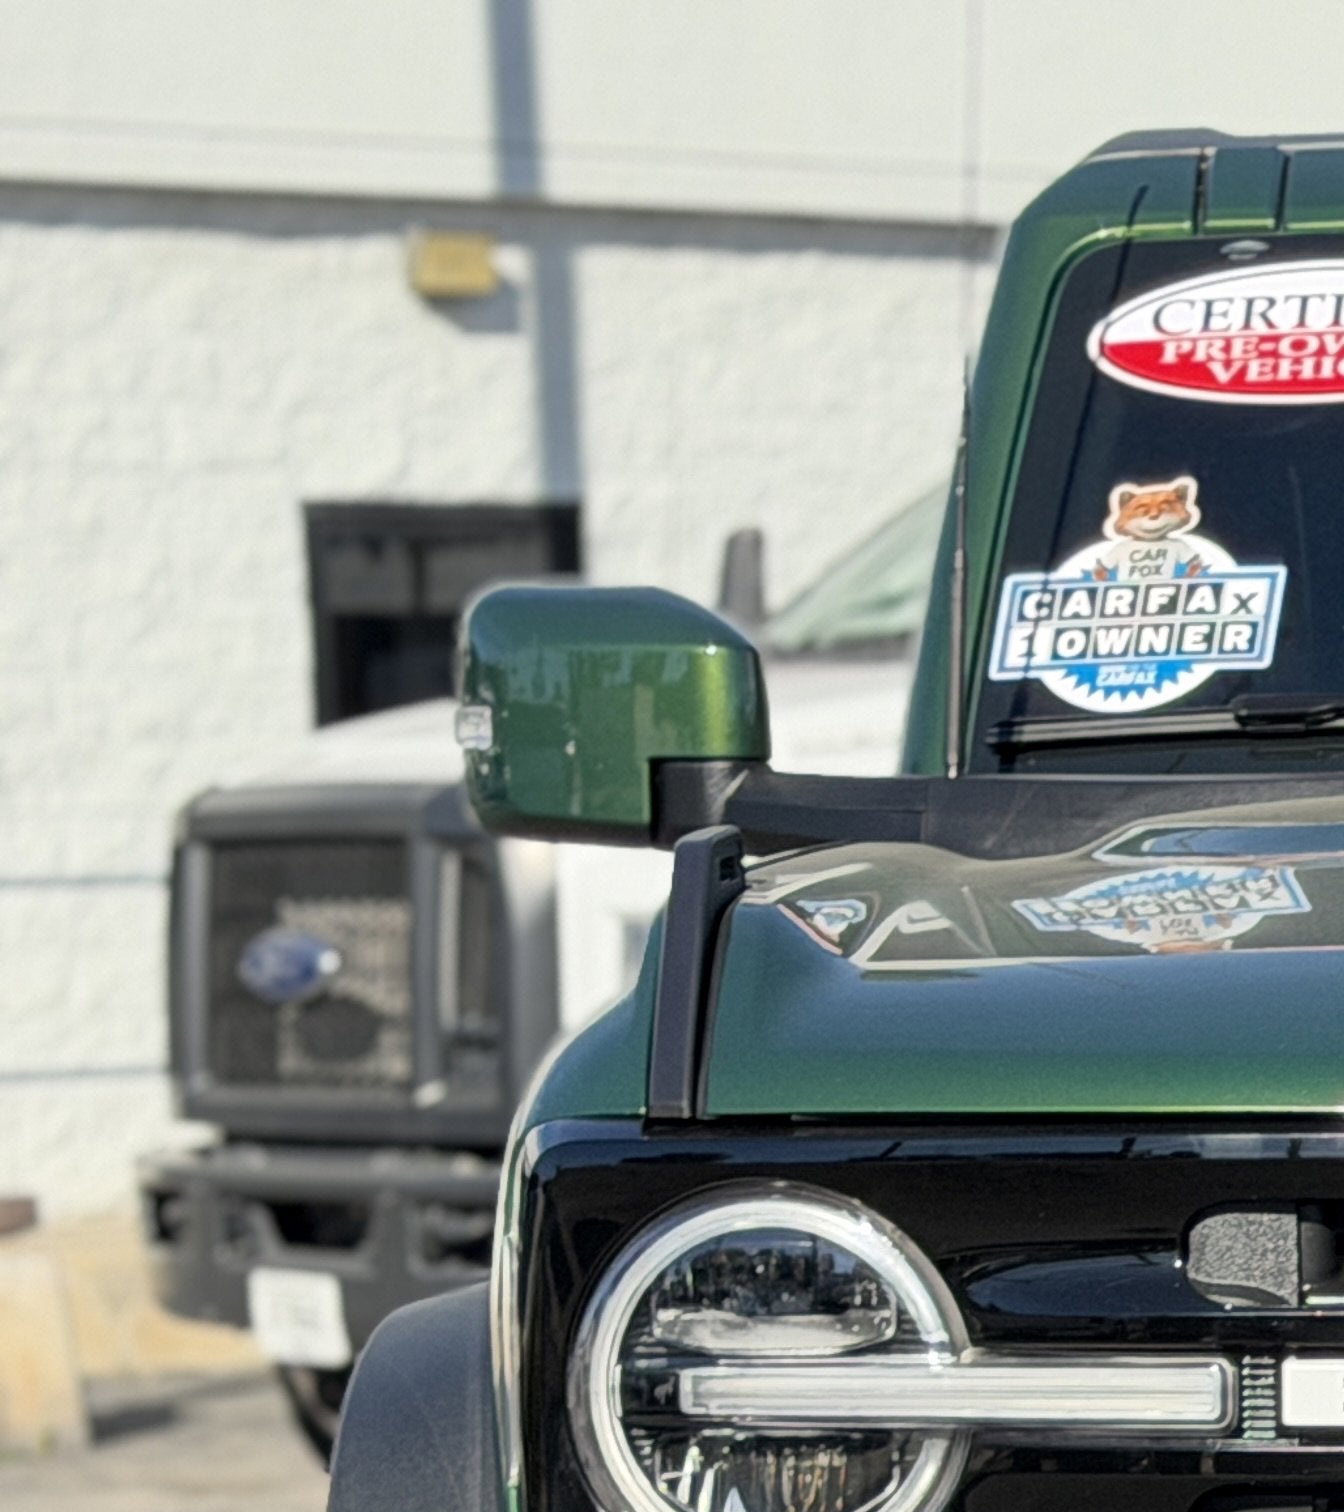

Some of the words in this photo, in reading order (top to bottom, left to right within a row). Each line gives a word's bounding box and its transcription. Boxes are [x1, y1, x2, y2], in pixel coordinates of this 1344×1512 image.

[1128, 548, 1168, 564] CAR
[1128, 564, 1163, 578] FOX
[1022, 584, 1258, 619] CARFAX
